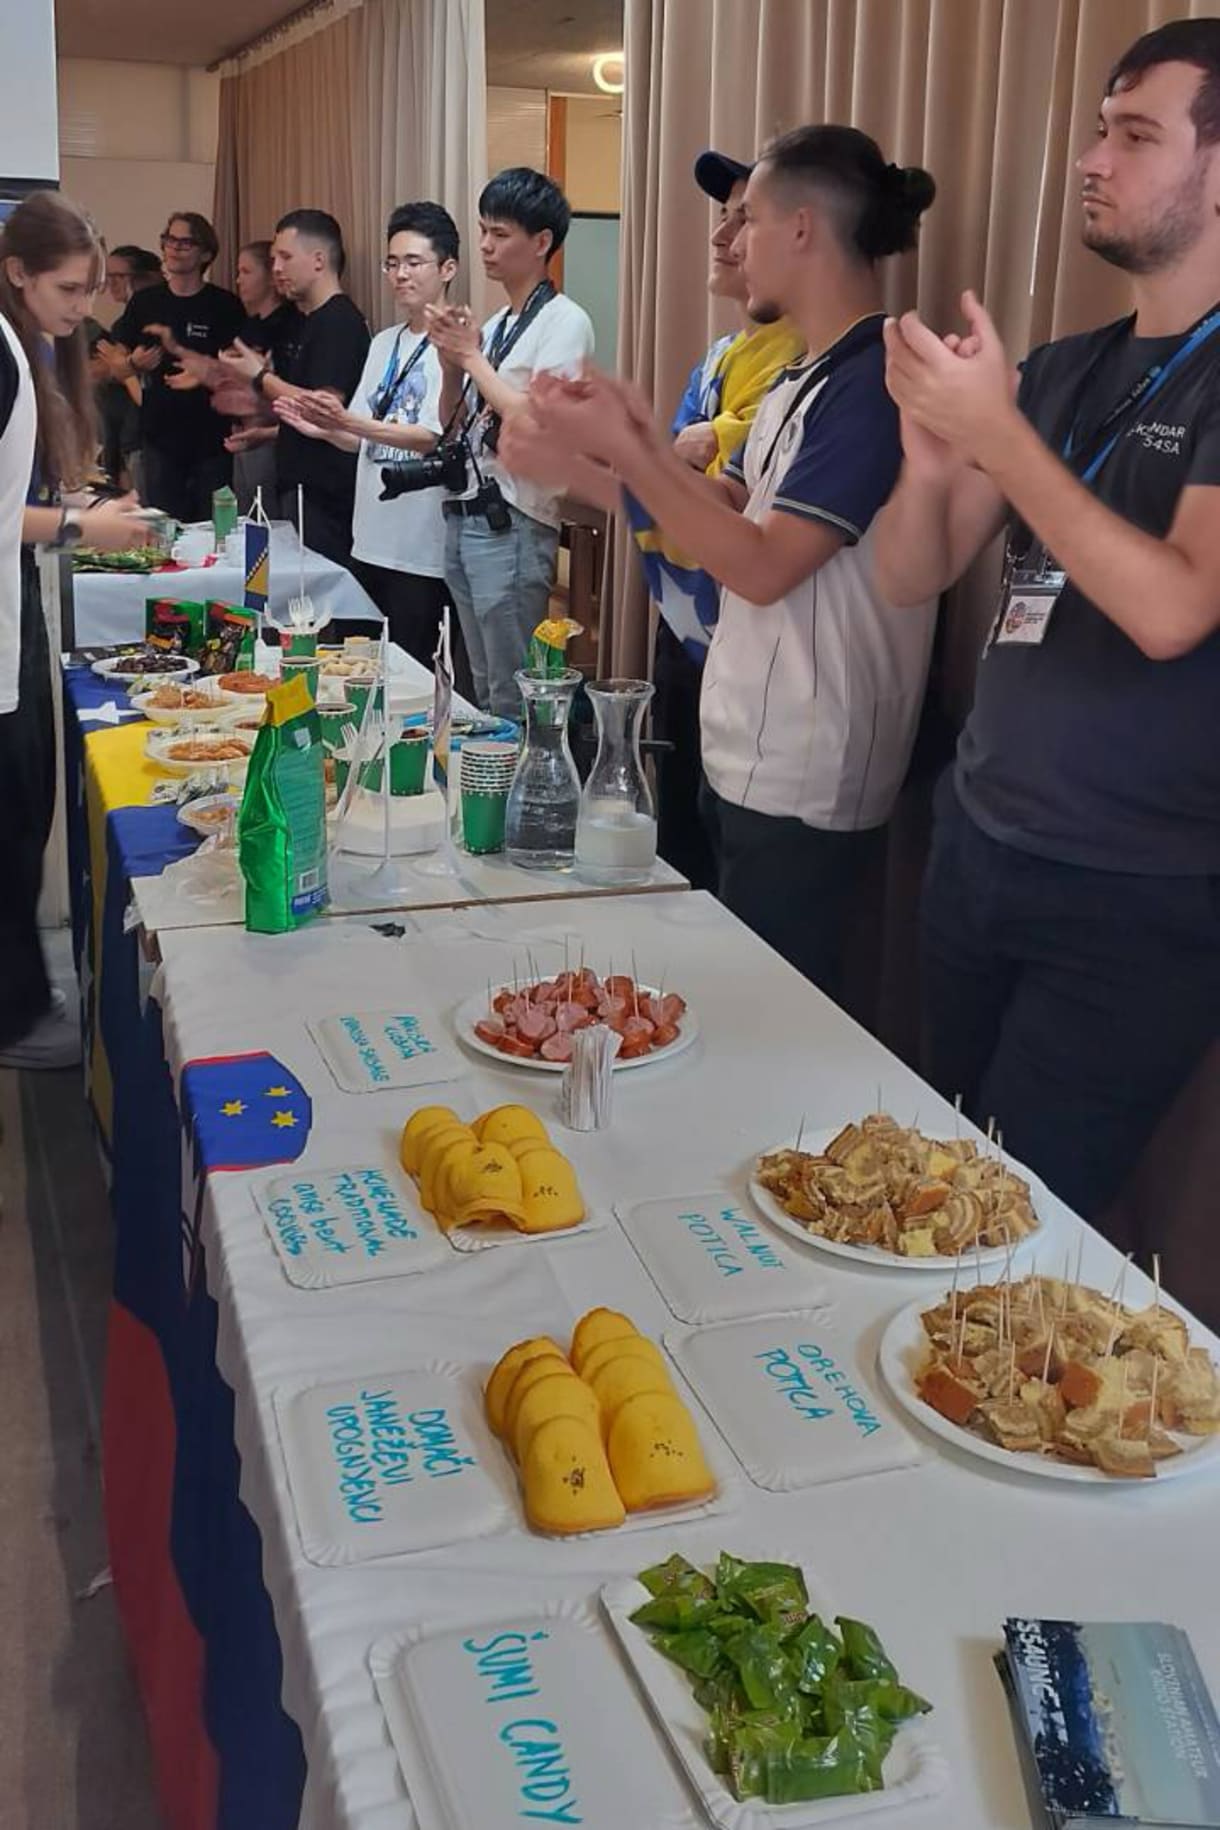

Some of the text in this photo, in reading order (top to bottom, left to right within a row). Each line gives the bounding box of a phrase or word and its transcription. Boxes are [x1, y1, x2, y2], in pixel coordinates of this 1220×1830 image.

[678, 1212, 743, 1277] POTICA
[720, 1207, 786, 1269] WALNUT
[754, 1348, 834, 1420] POTICA
[798, 1344, 881, 1437] OREHOVA
[325, 1405, 384, 1523] UPOGNJENCI
[360, 1390, 418, 1485] JANEŽEVI
[408, 1409, 476, 1478] DOMAČI
[462, 1631, 583, 1824] ŠUMI CANDY
